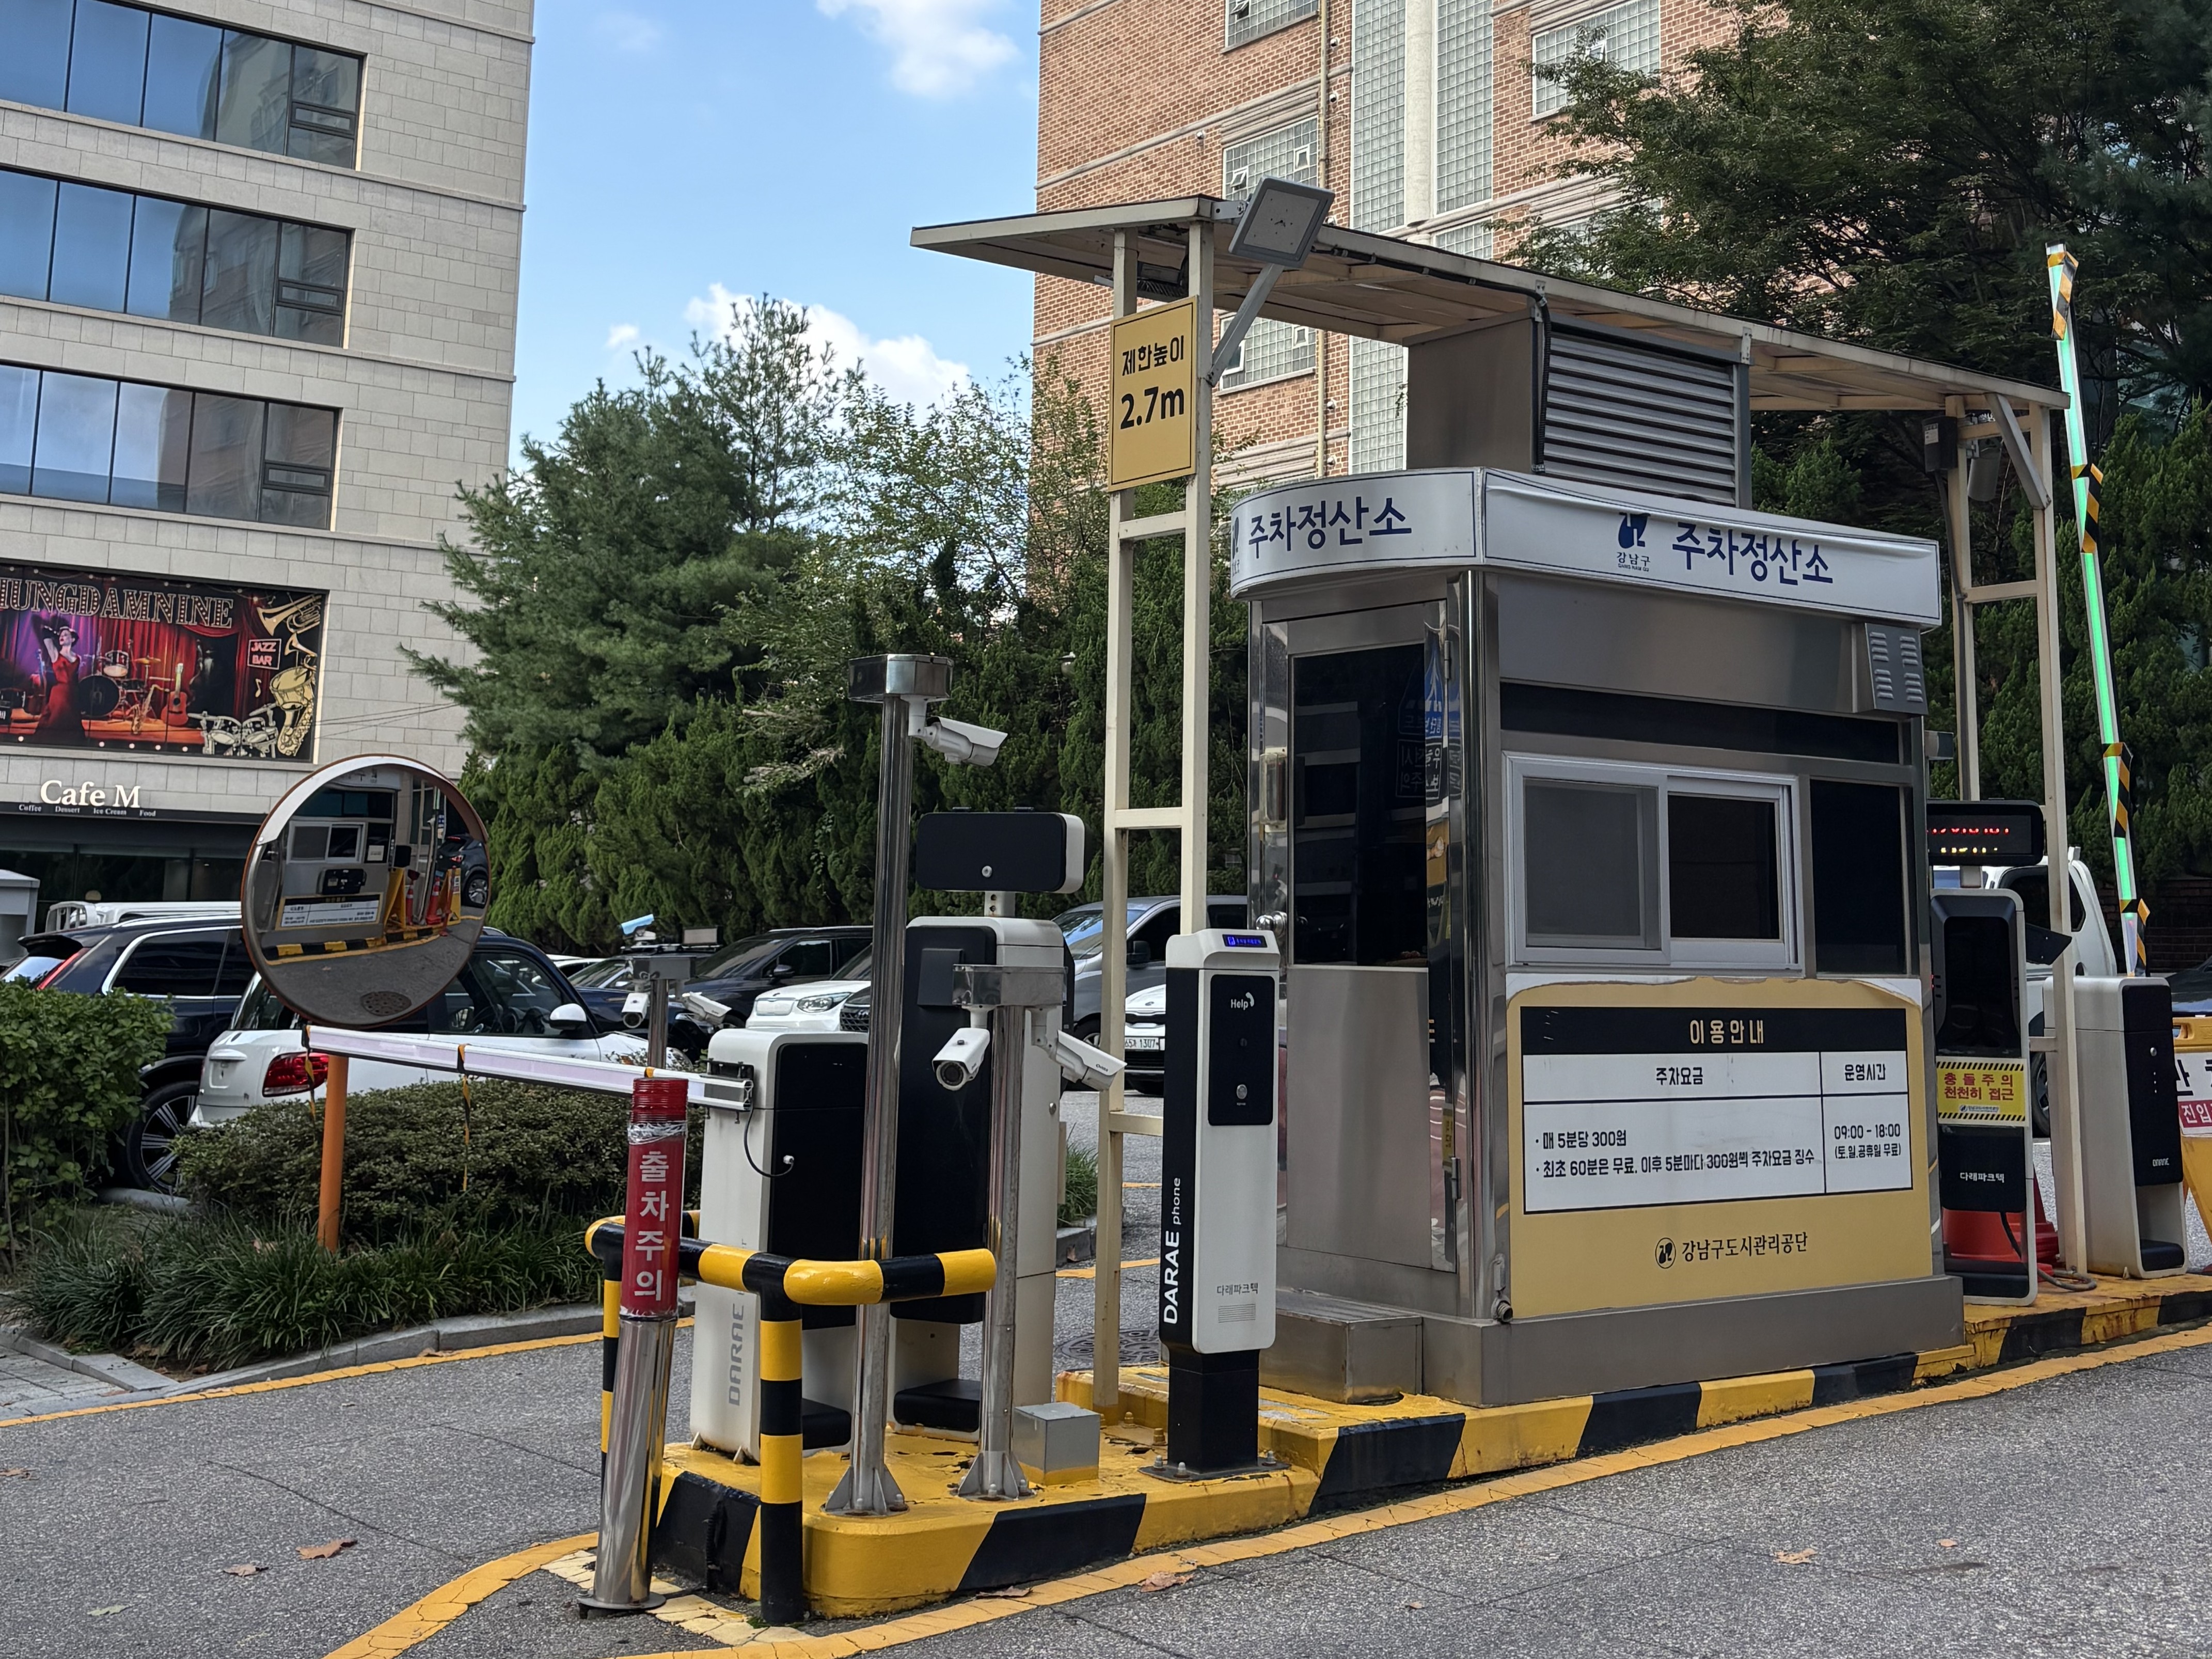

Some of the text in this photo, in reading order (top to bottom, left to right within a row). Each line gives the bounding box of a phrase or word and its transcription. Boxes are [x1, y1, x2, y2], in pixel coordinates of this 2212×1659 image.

[1122, 335, 1184, 376] 제한높이
[1120, 386, 1184, 430] 2.7m
[1249, 496, 1412, 559] 주차정산소
[1617, 552, 1651, 566] 강남구
[1672, 522, 1833, 586] 주차정산소
[251, 642, 276, 652] JAZZ
[252, 654, 272, 666] BAR
[40, 780, 141, 808] Cafe M
[19, 804, 42, 812] Coffee
[55, 805, 80, 814] Dessert
[1230, 999, 1249, 1010] Help
[1690, 1020, 1764, 1044] 이용안내
[1140, 1039, 1156, 1048] 1307
[1656, 1067, 1703, 1085] 주차요금
[1844, 1064, 1886, 1081] 운영시간
[1944, 1086, 2014, 1100] 천천히 접근
[2181, 1103, 2212, 1124] 진입
[1543, 1130, 1626, 1149] 매 5분당 300원
[1834, 1125, 1863, 1140] 09:00
[1875, 1123, 1901, 1138] 18:00
[1883, 1143, 1901, 1157] 무료)
[1543, 1160, 1567, 1178] 최초
[1570, 1158, 1609, 1176] 60분은
[1641, 1156, 1662, 1173] 이후
[1665, 1154, 1703, 1172] 5분마다
[1707, 1151, 1748, 1169] 300원씩
[1751, 1150, 1792, 1167] 주차요금
[1795, 1149, 1814, 1165] 징수
[1960, 1172, 2004, 1183] 다래파크텍
[1163, 1178, 1181, 1324] DARAE phone
[1682, 1231, 1808, 1262] 강남구도시관리공단
[1216, 1282, 1258, 1296] 다래파크텍
[729, 1303, 744, 1406] DARAE
